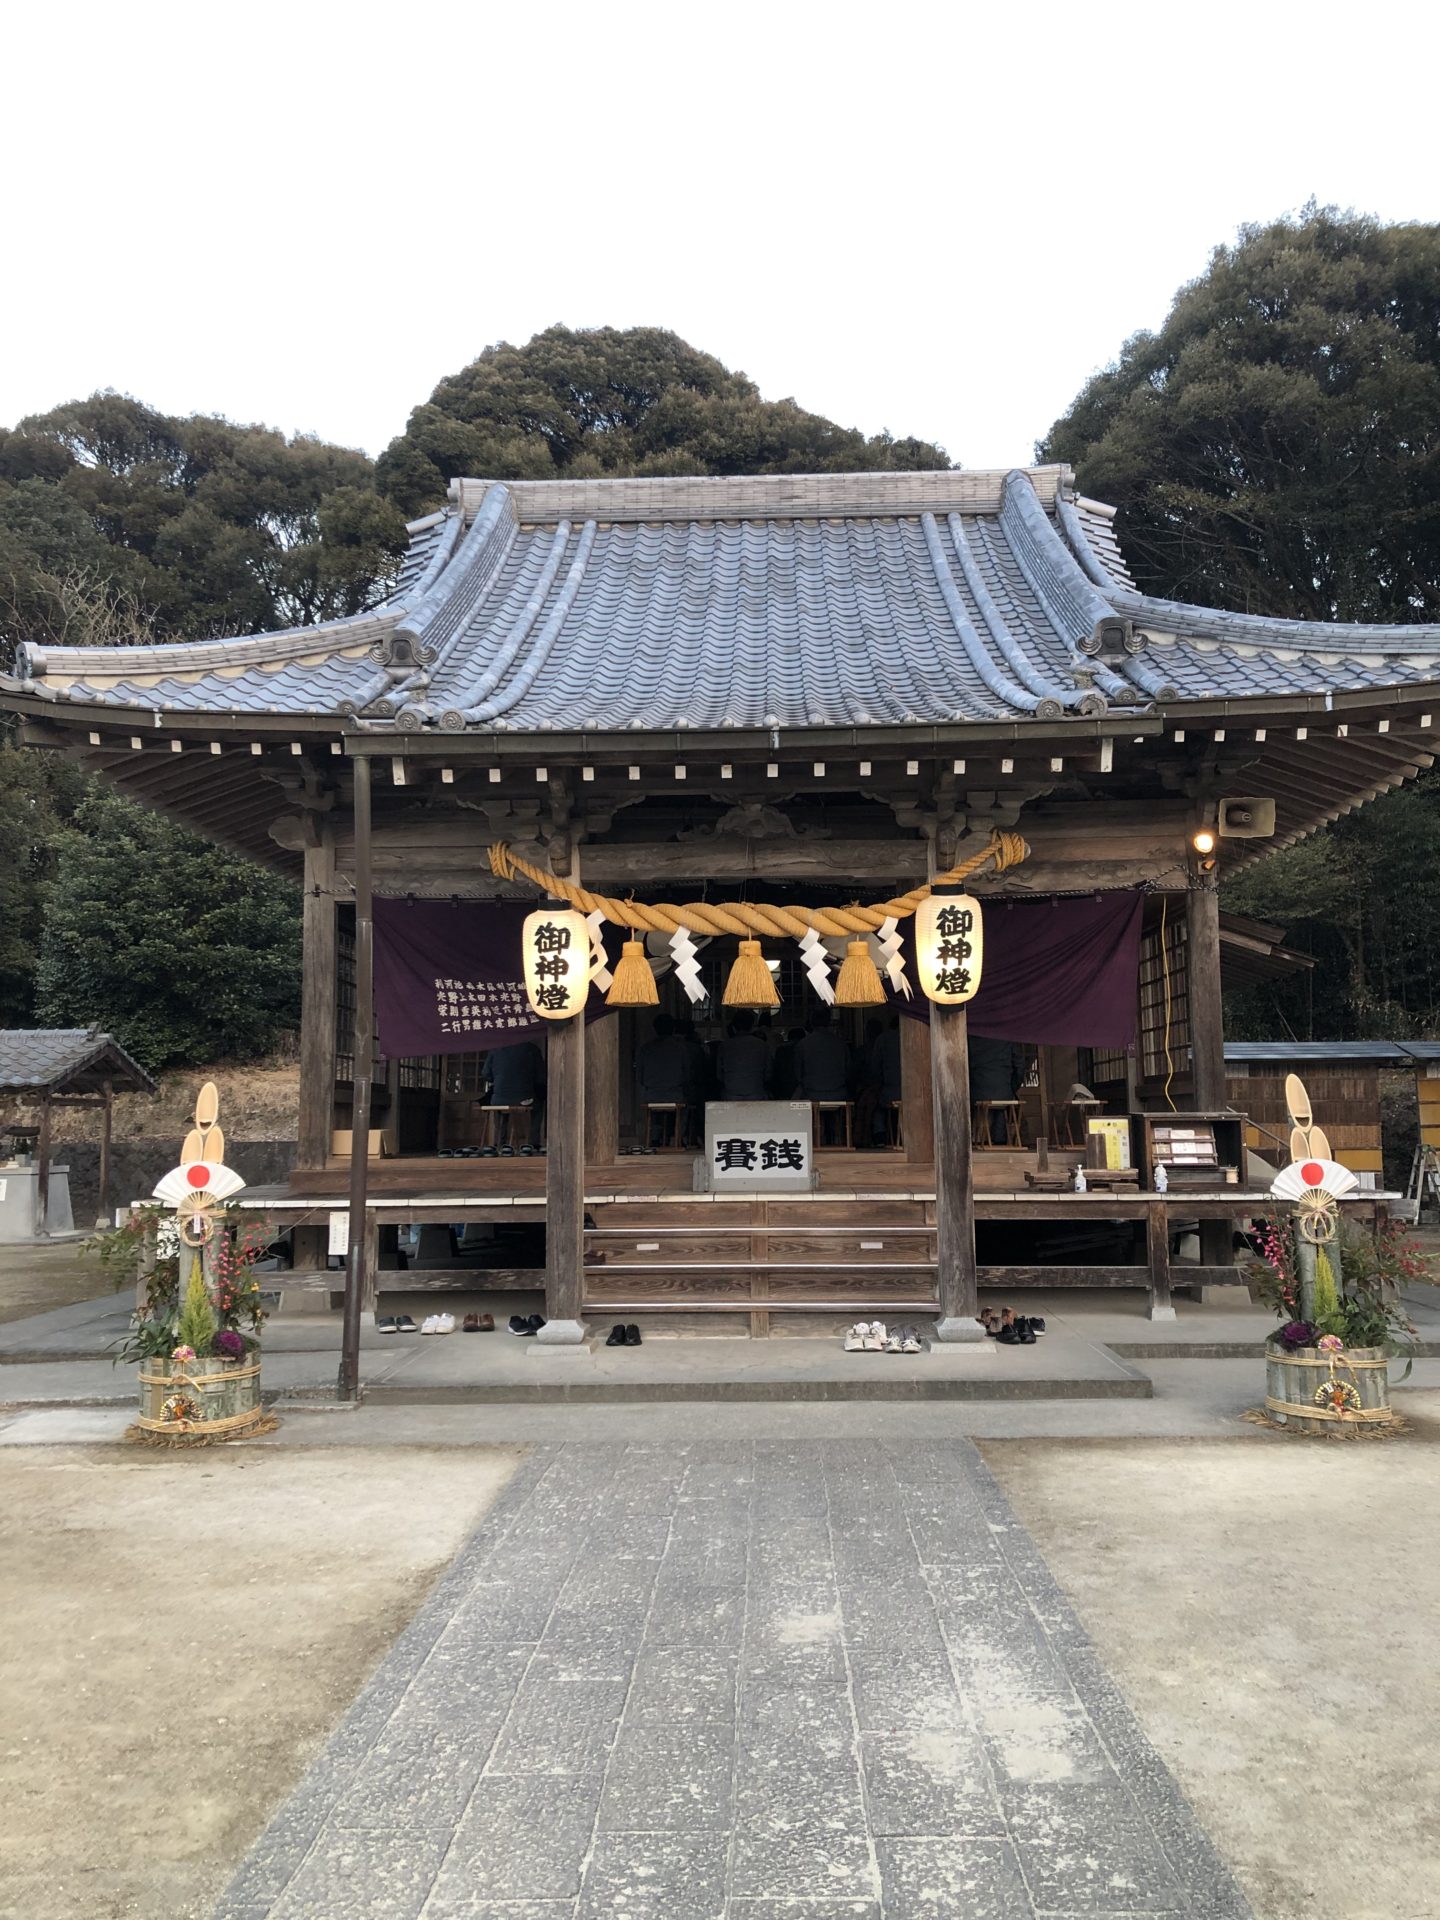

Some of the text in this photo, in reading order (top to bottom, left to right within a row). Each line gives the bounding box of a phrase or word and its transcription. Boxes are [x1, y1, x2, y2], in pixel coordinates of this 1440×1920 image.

[534, 921, 571, 1010] 御神燈
[935, 905, 973, 995] 御神燈
[715, 1138, 804, 1171] 賽銭
